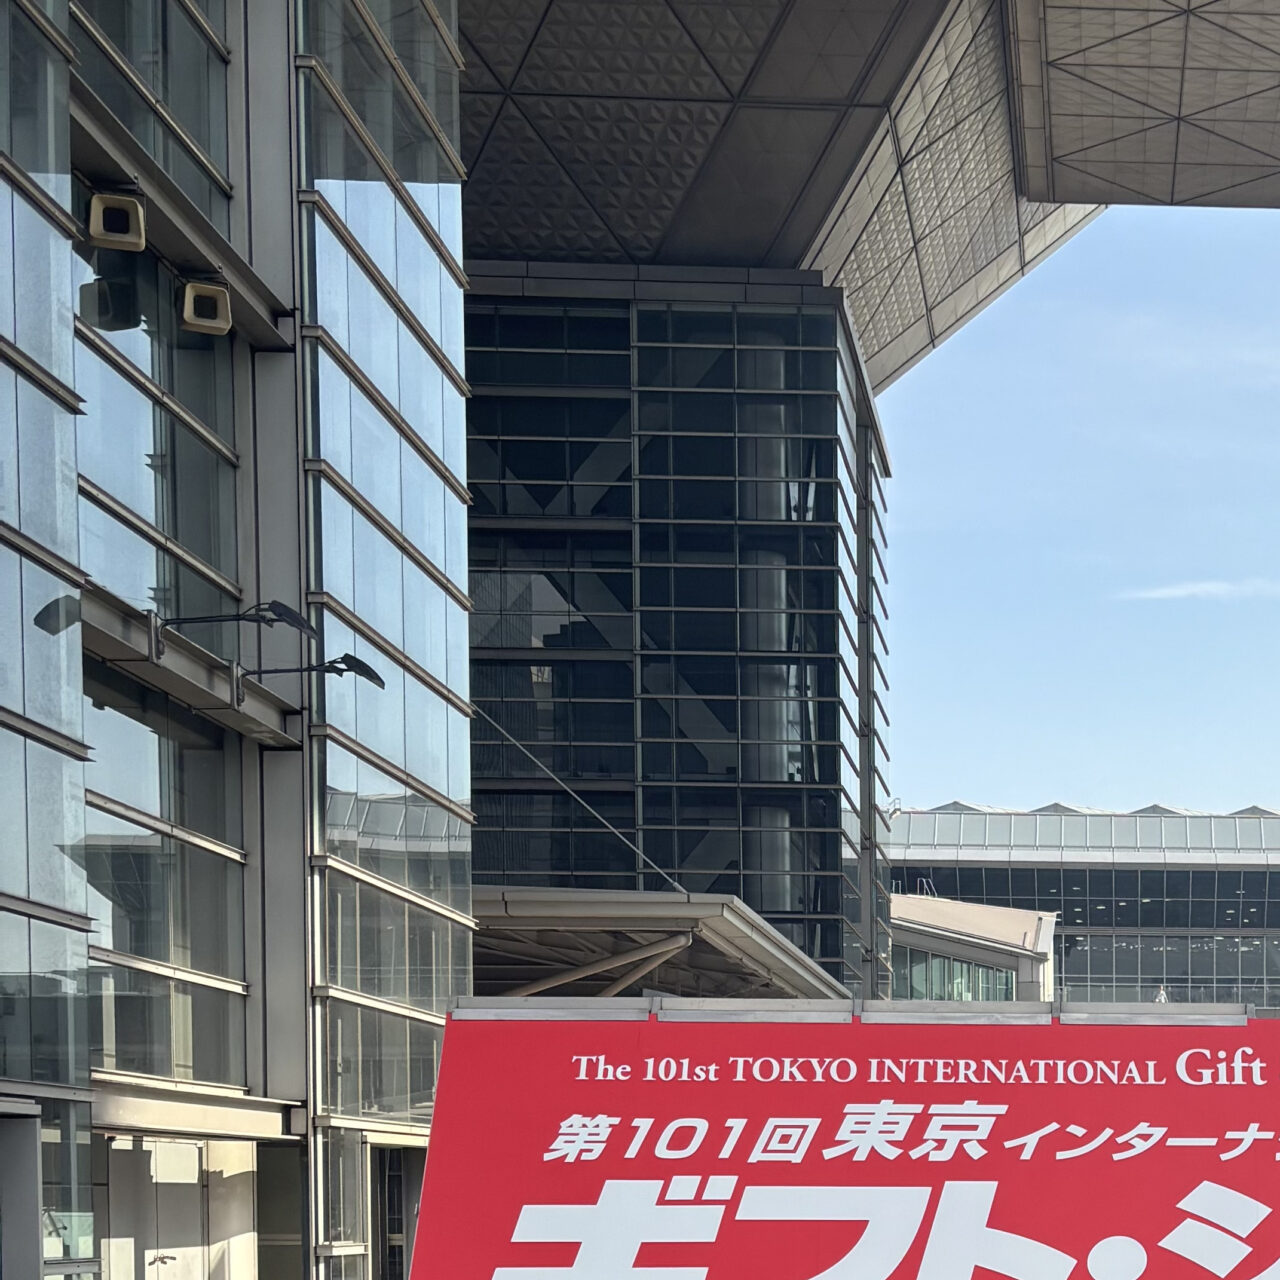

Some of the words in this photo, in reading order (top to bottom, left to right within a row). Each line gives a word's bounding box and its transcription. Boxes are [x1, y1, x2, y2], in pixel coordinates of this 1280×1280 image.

[572, 1056, 631, 1082] The
[642, 1057, 720, 1083] 101st
[729, 1057, 858, 1084] TOKYO
[867, 1058, 1166, 1086] INTERNATIONAL
[1176, 1047, 1267, 1087] Gift
